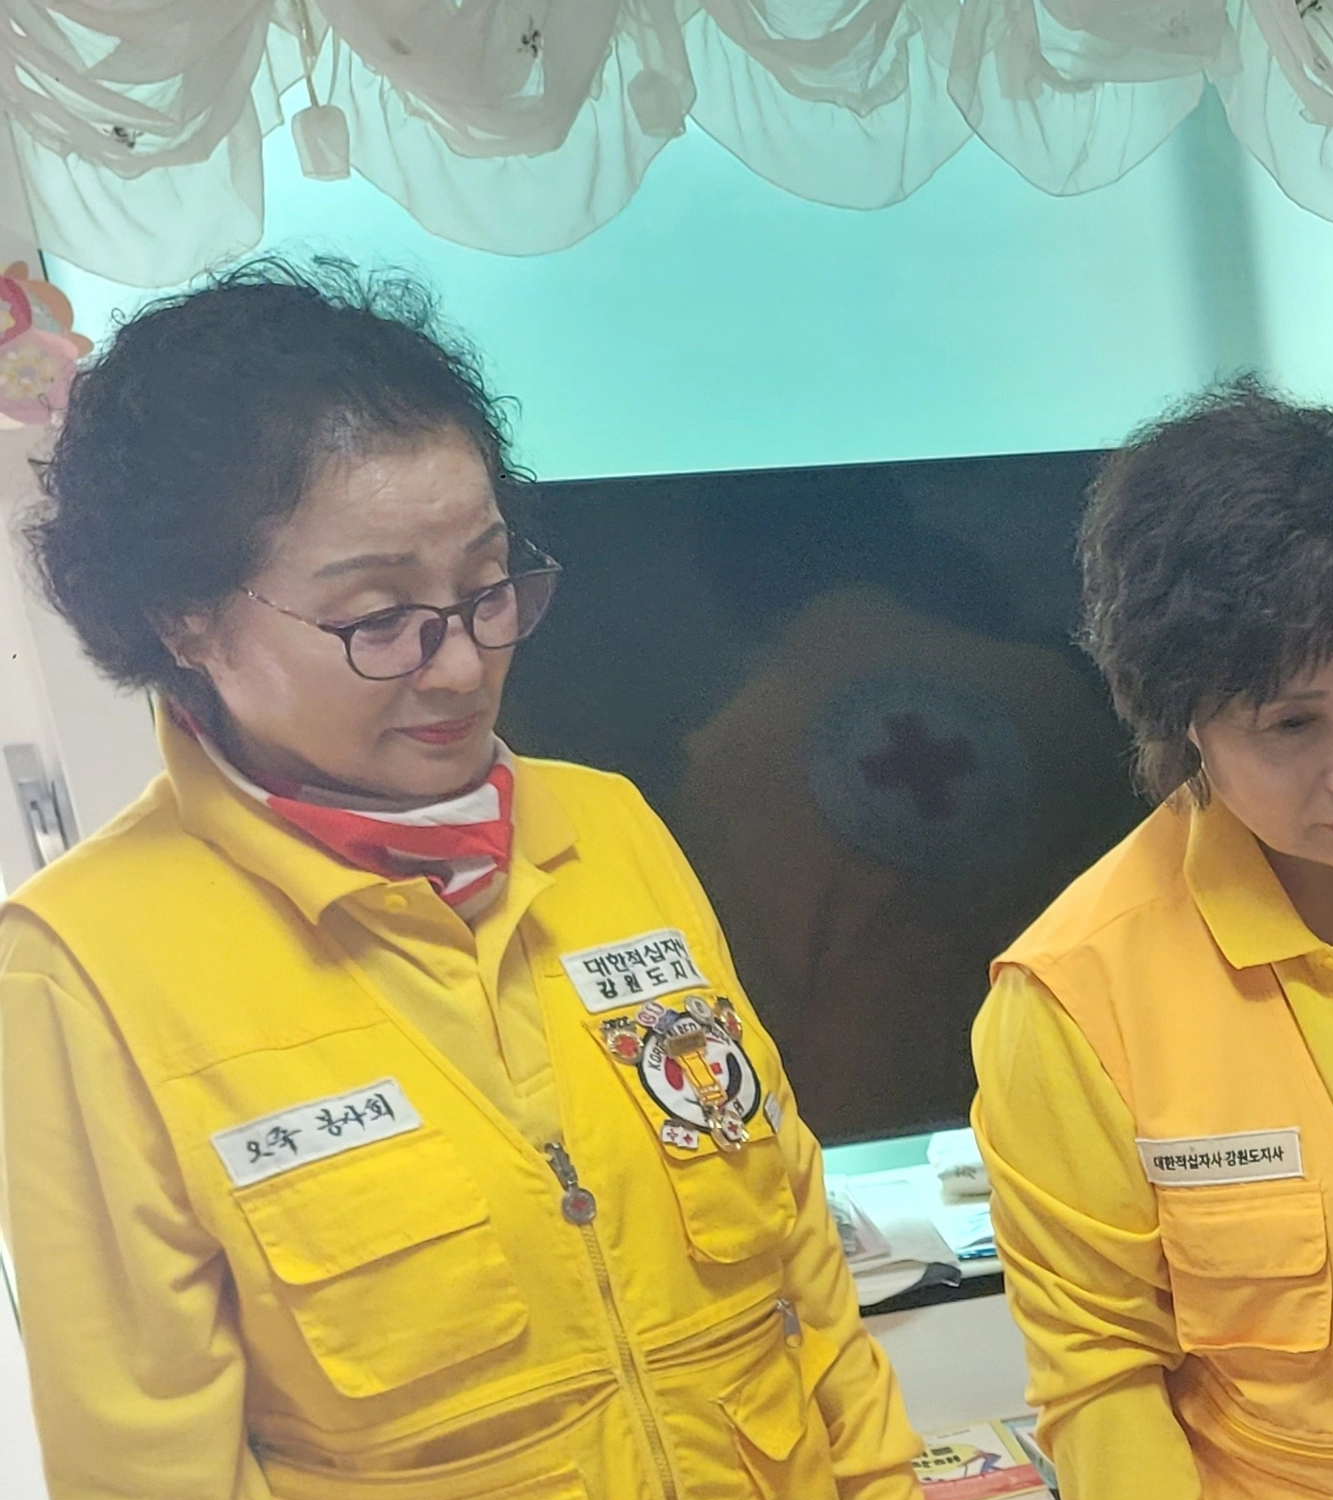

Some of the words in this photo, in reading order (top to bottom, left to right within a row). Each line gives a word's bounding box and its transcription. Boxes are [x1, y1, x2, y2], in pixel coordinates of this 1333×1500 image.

[314, 1093, 395, 1137] 봉사회
[1153, 1151, 1222, 1170] 대한적십자사
[1225, 1145, 1284, 1166] 강원도지사
